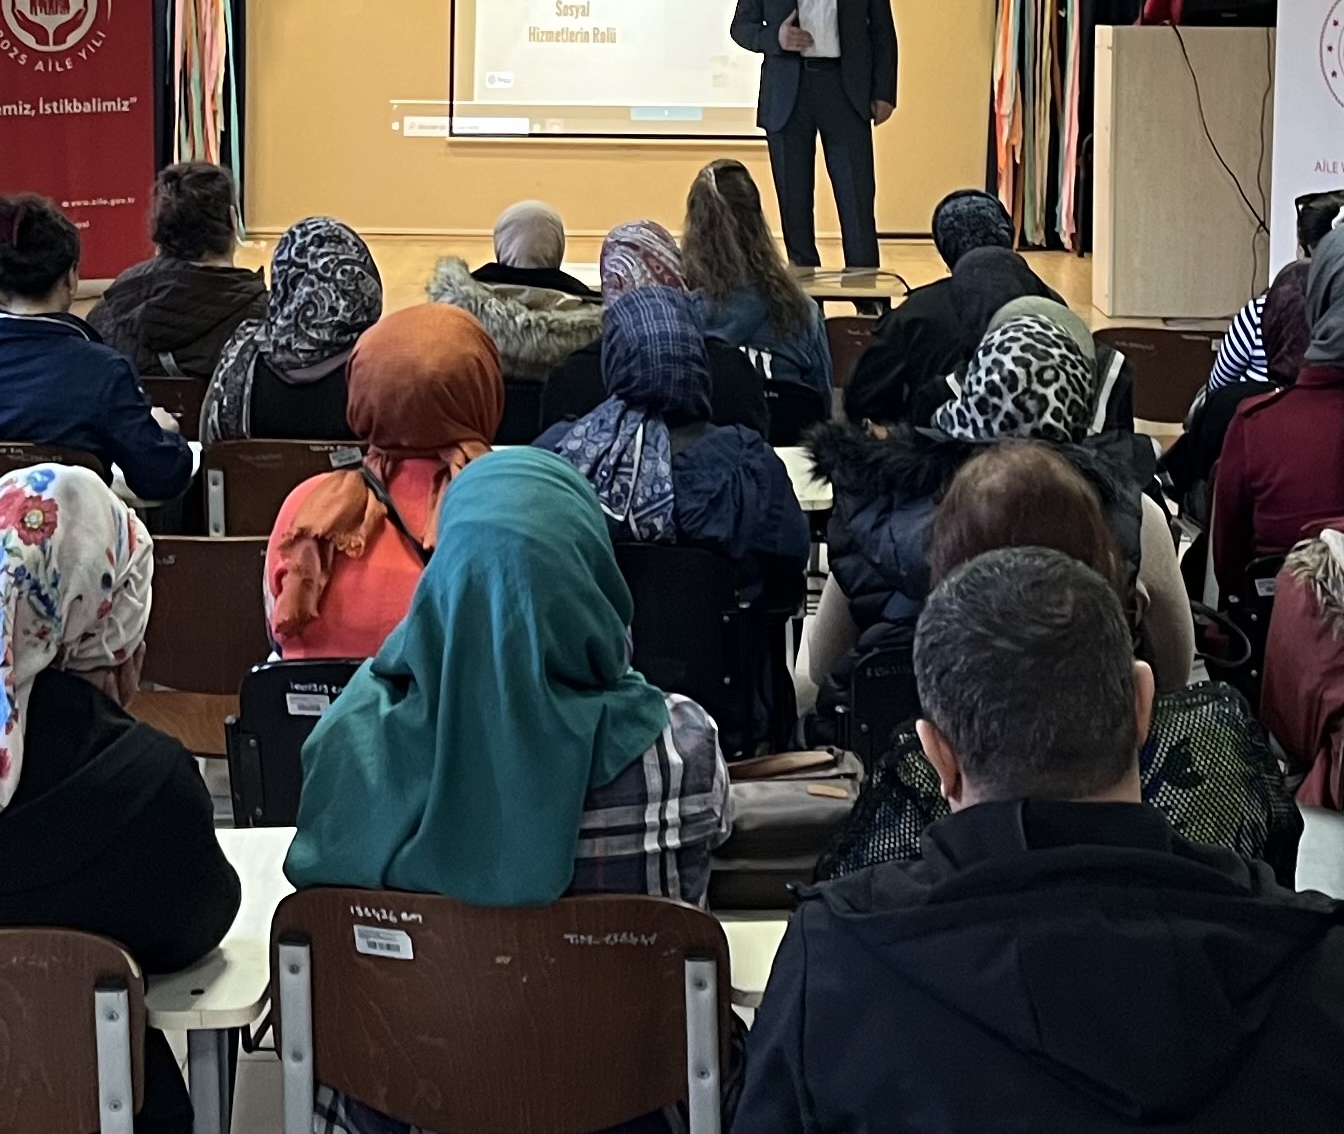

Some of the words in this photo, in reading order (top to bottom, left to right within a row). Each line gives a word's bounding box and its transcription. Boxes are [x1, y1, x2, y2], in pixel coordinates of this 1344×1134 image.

[555, 0, 591, 20] Sosyal
[528, 26, 591, 44] Hizmetlerin
[592, 26, 617, 44] Rolü
[33, 58, 74, 73] AİLE
[1314, 159, 1339, 174] AİLE
